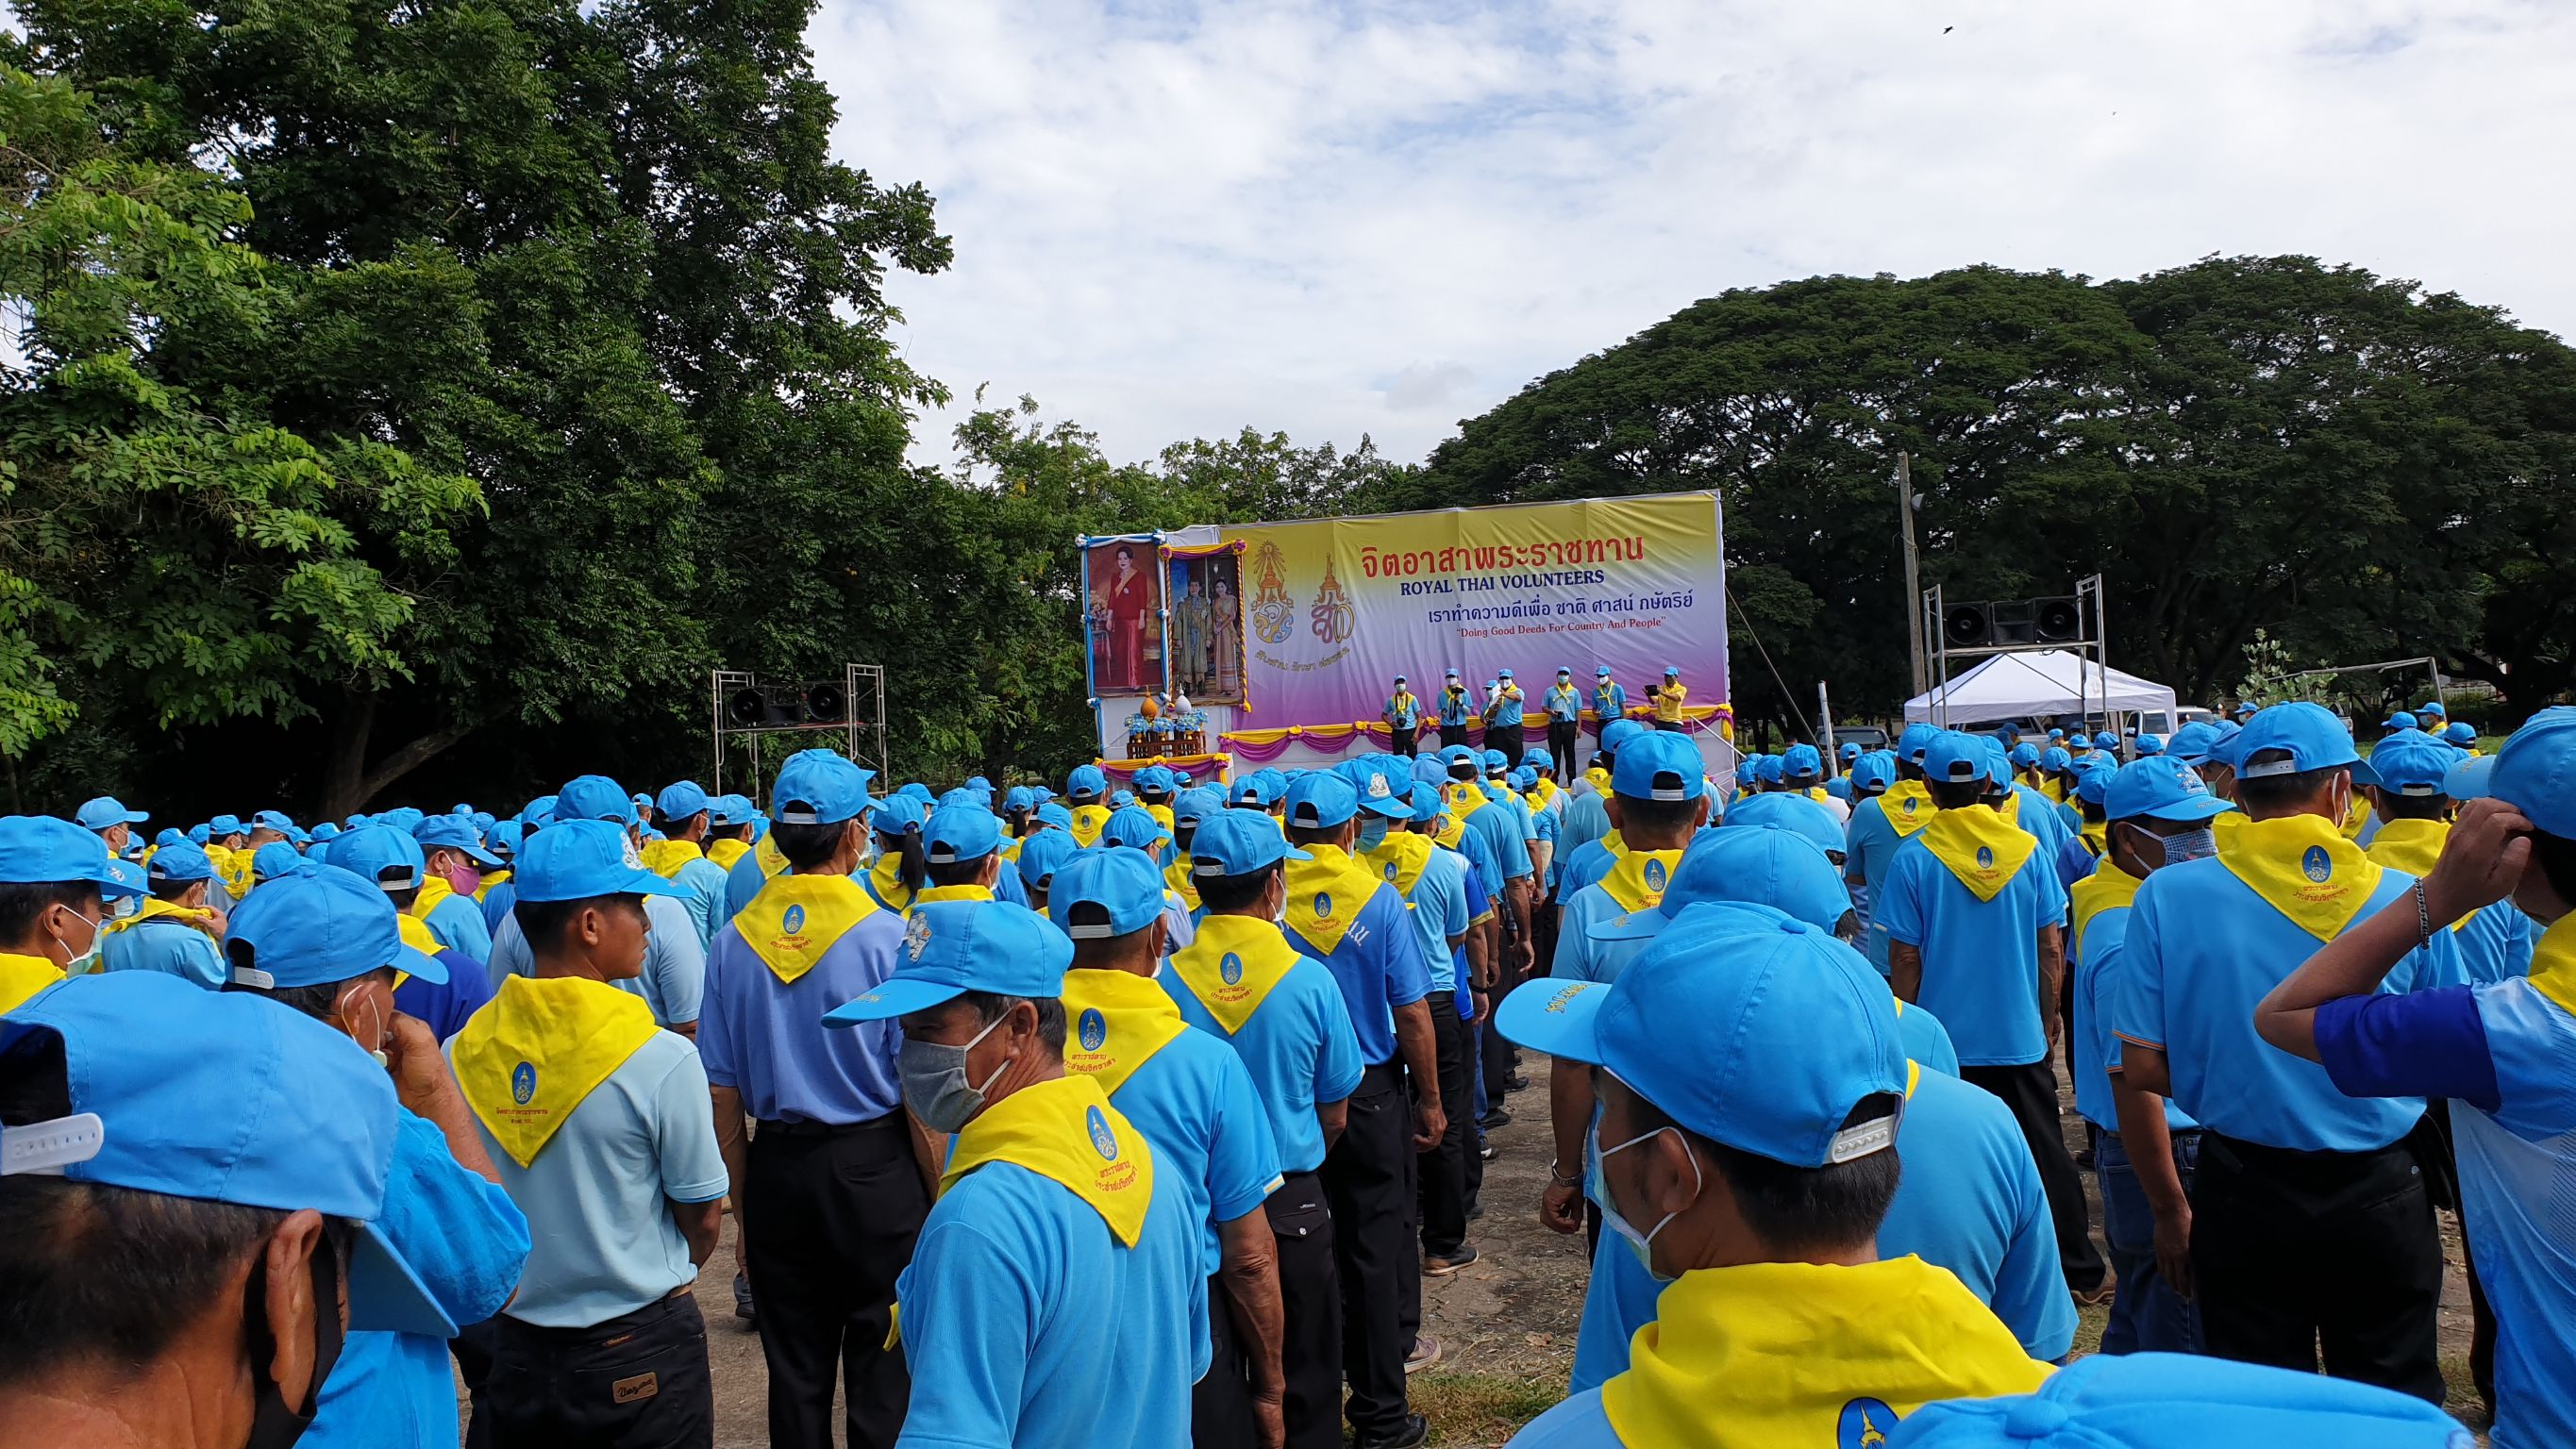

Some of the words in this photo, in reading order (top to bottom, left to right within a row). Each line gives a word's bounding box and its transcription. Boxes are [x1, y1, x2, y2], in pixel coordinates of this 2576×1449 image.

[1361, 536, 1644, 578] จิตอาสาพระราชทาน
[1400, 579, 1452, 596] ROYAL
[1457, 576, 1496, 591] THAI
[1500, 569, 1605, 590] VOLUNTEERS
[1428, 594, 1550, 623] เราทำความดีเพื่อ
[1556, 597, 1586, 615] ชาติ
[1592, 592, 1634, 613] ศาสน์
[1639, 589, 1694, 610] กษัตริย์
[1491, 625, 1514, 636] Good
[1518, 624, 1547, 634] Deeds
[1549, 623, 1564, 633] For
[1567, 621, 1605, 631] Country
[1607, 618, 1627, 629] And
